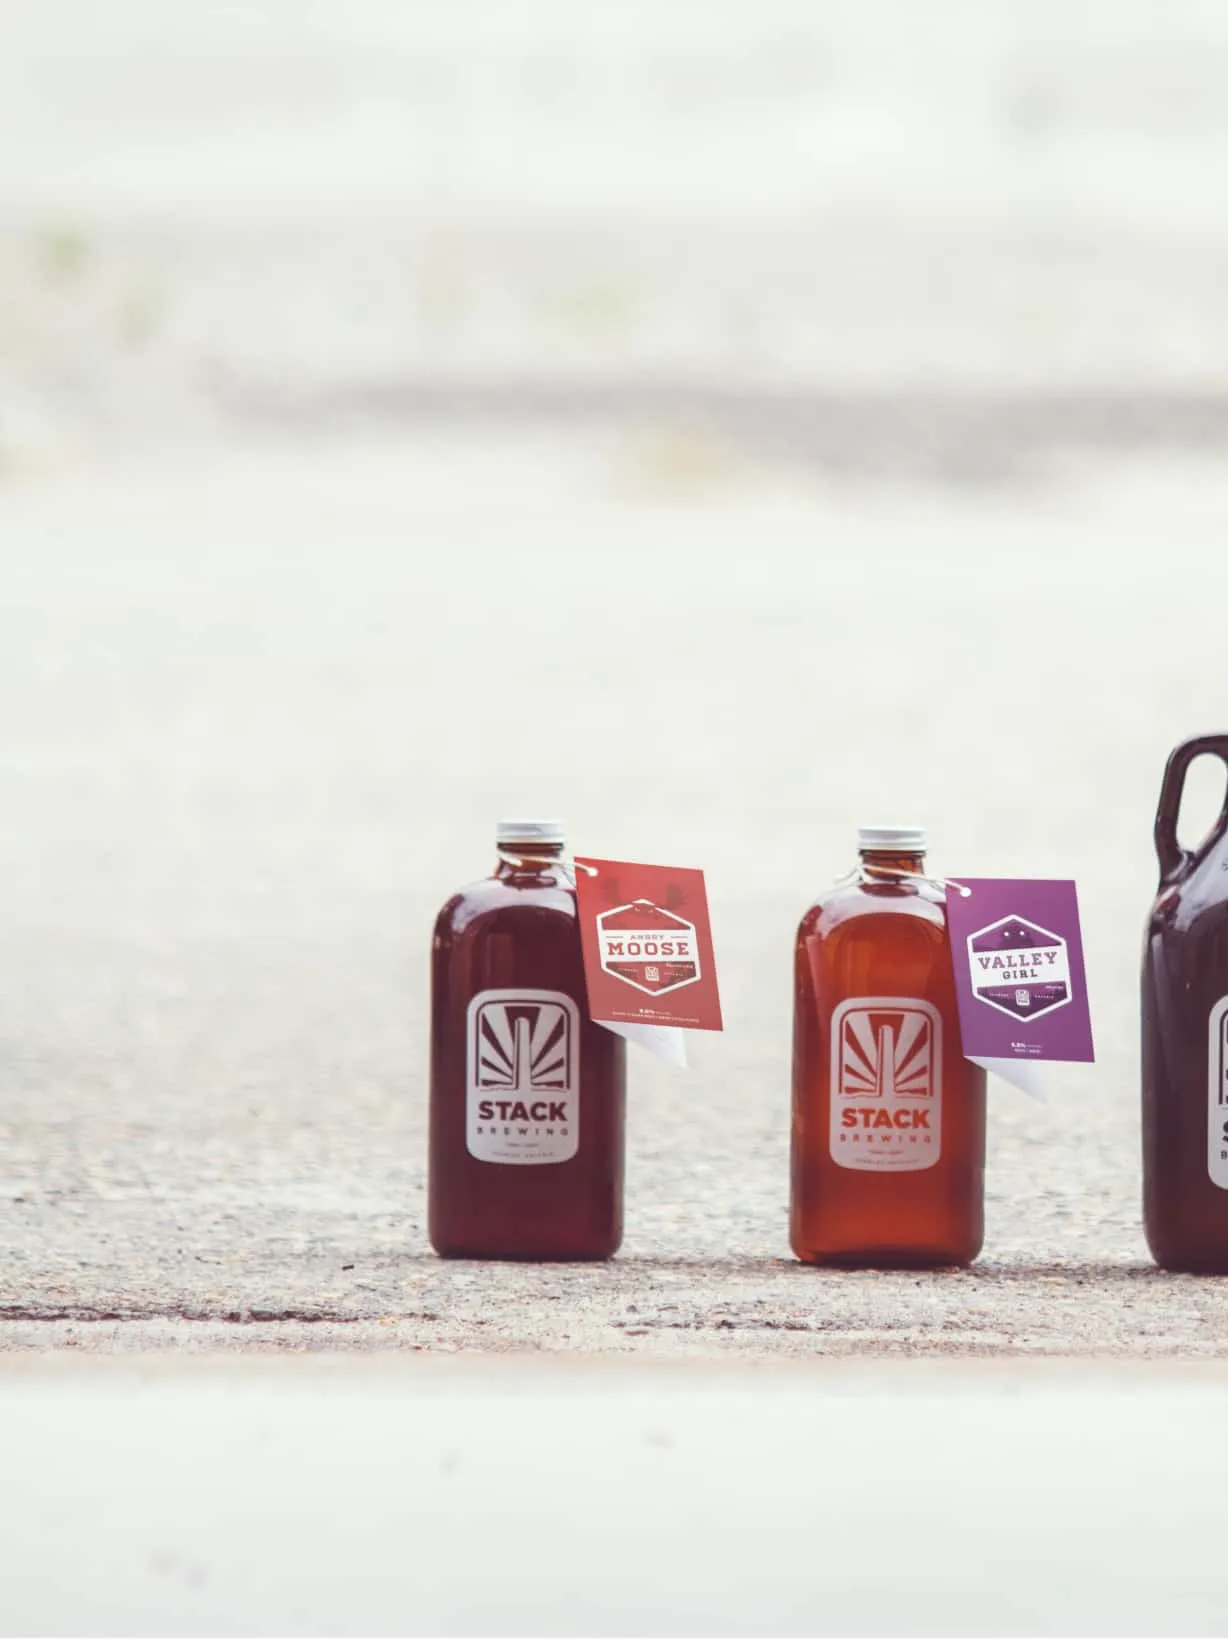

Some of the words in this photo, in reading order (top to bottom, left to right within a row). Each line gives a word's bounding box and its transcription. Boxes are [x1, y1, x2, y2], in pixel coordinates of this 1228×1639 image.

[607, 942, 690, 956] MOOSE
[978, 951, 1058, 970] VALLEY
[1002, 969, 1038, 980] GIRL
[478, 1100, 569, 1121] STACK
[841, 1107, 931, 1129] STACK
[476, 1126, 569, 1136] BREWING
[839, 1133, 932, 1143] BREWING
